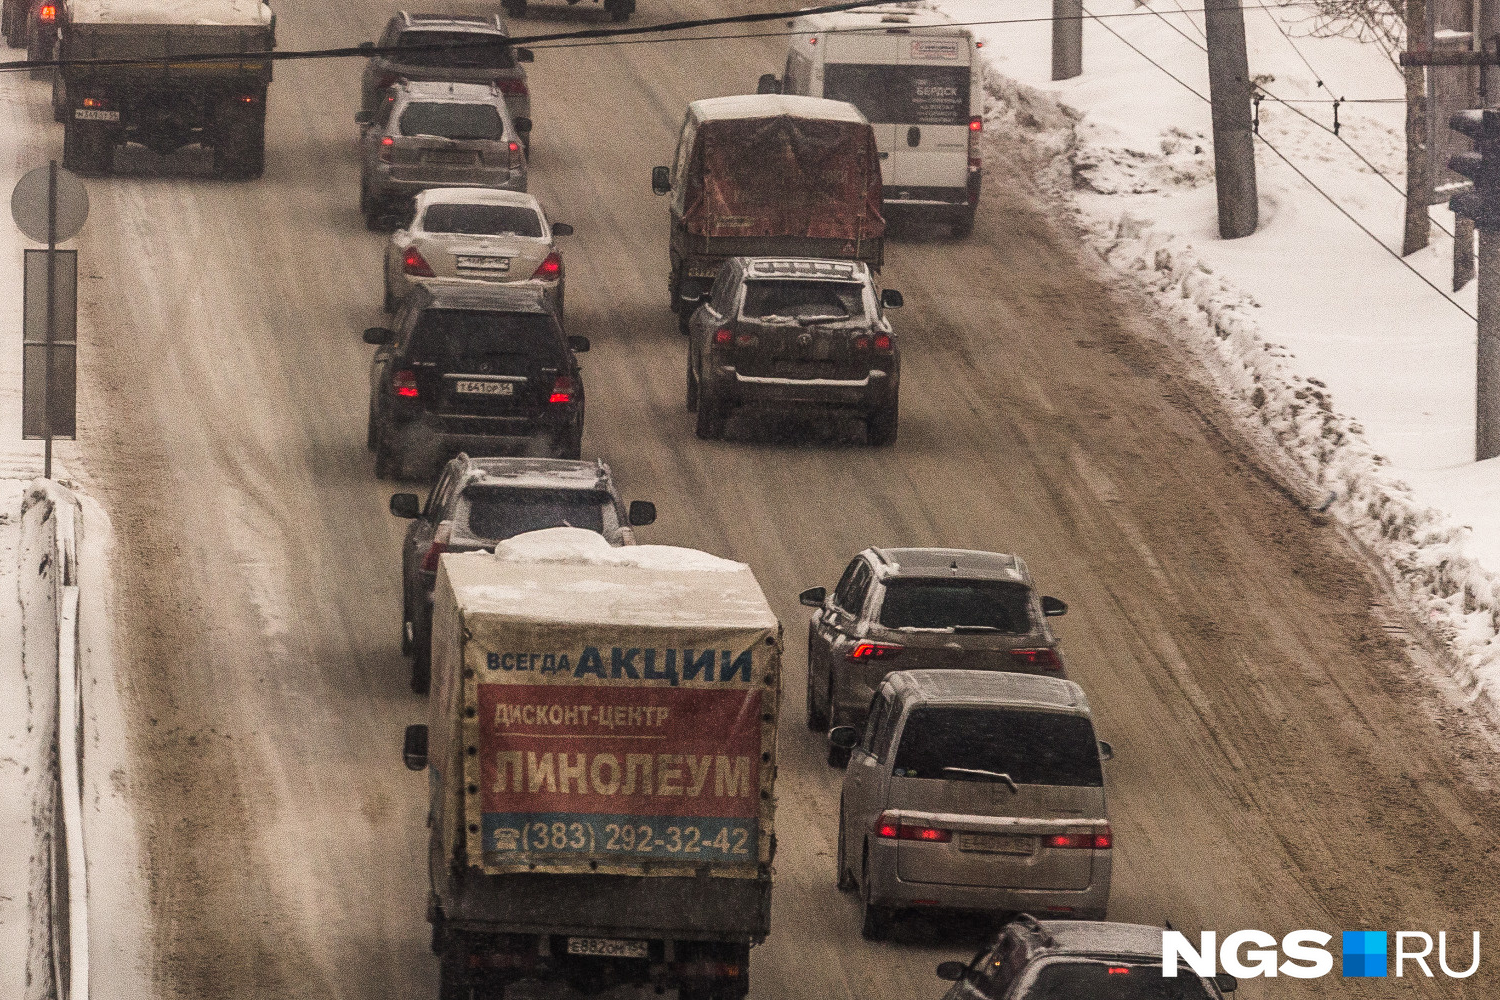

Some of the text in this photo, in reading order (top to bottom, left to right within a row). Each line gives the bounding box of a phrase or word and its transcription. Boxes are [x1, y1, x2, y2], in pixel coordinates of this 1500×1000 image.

[486, 646, 753, 686] ВСЕГДА АКЦИИ
[494, 704, 669, 729] ДИСКОНТ-ЦЕНТР
[492, 750, 750, 798] ЛИНОЛЕУМ
[522, 822, 749, 854] (383) 292-32-42
